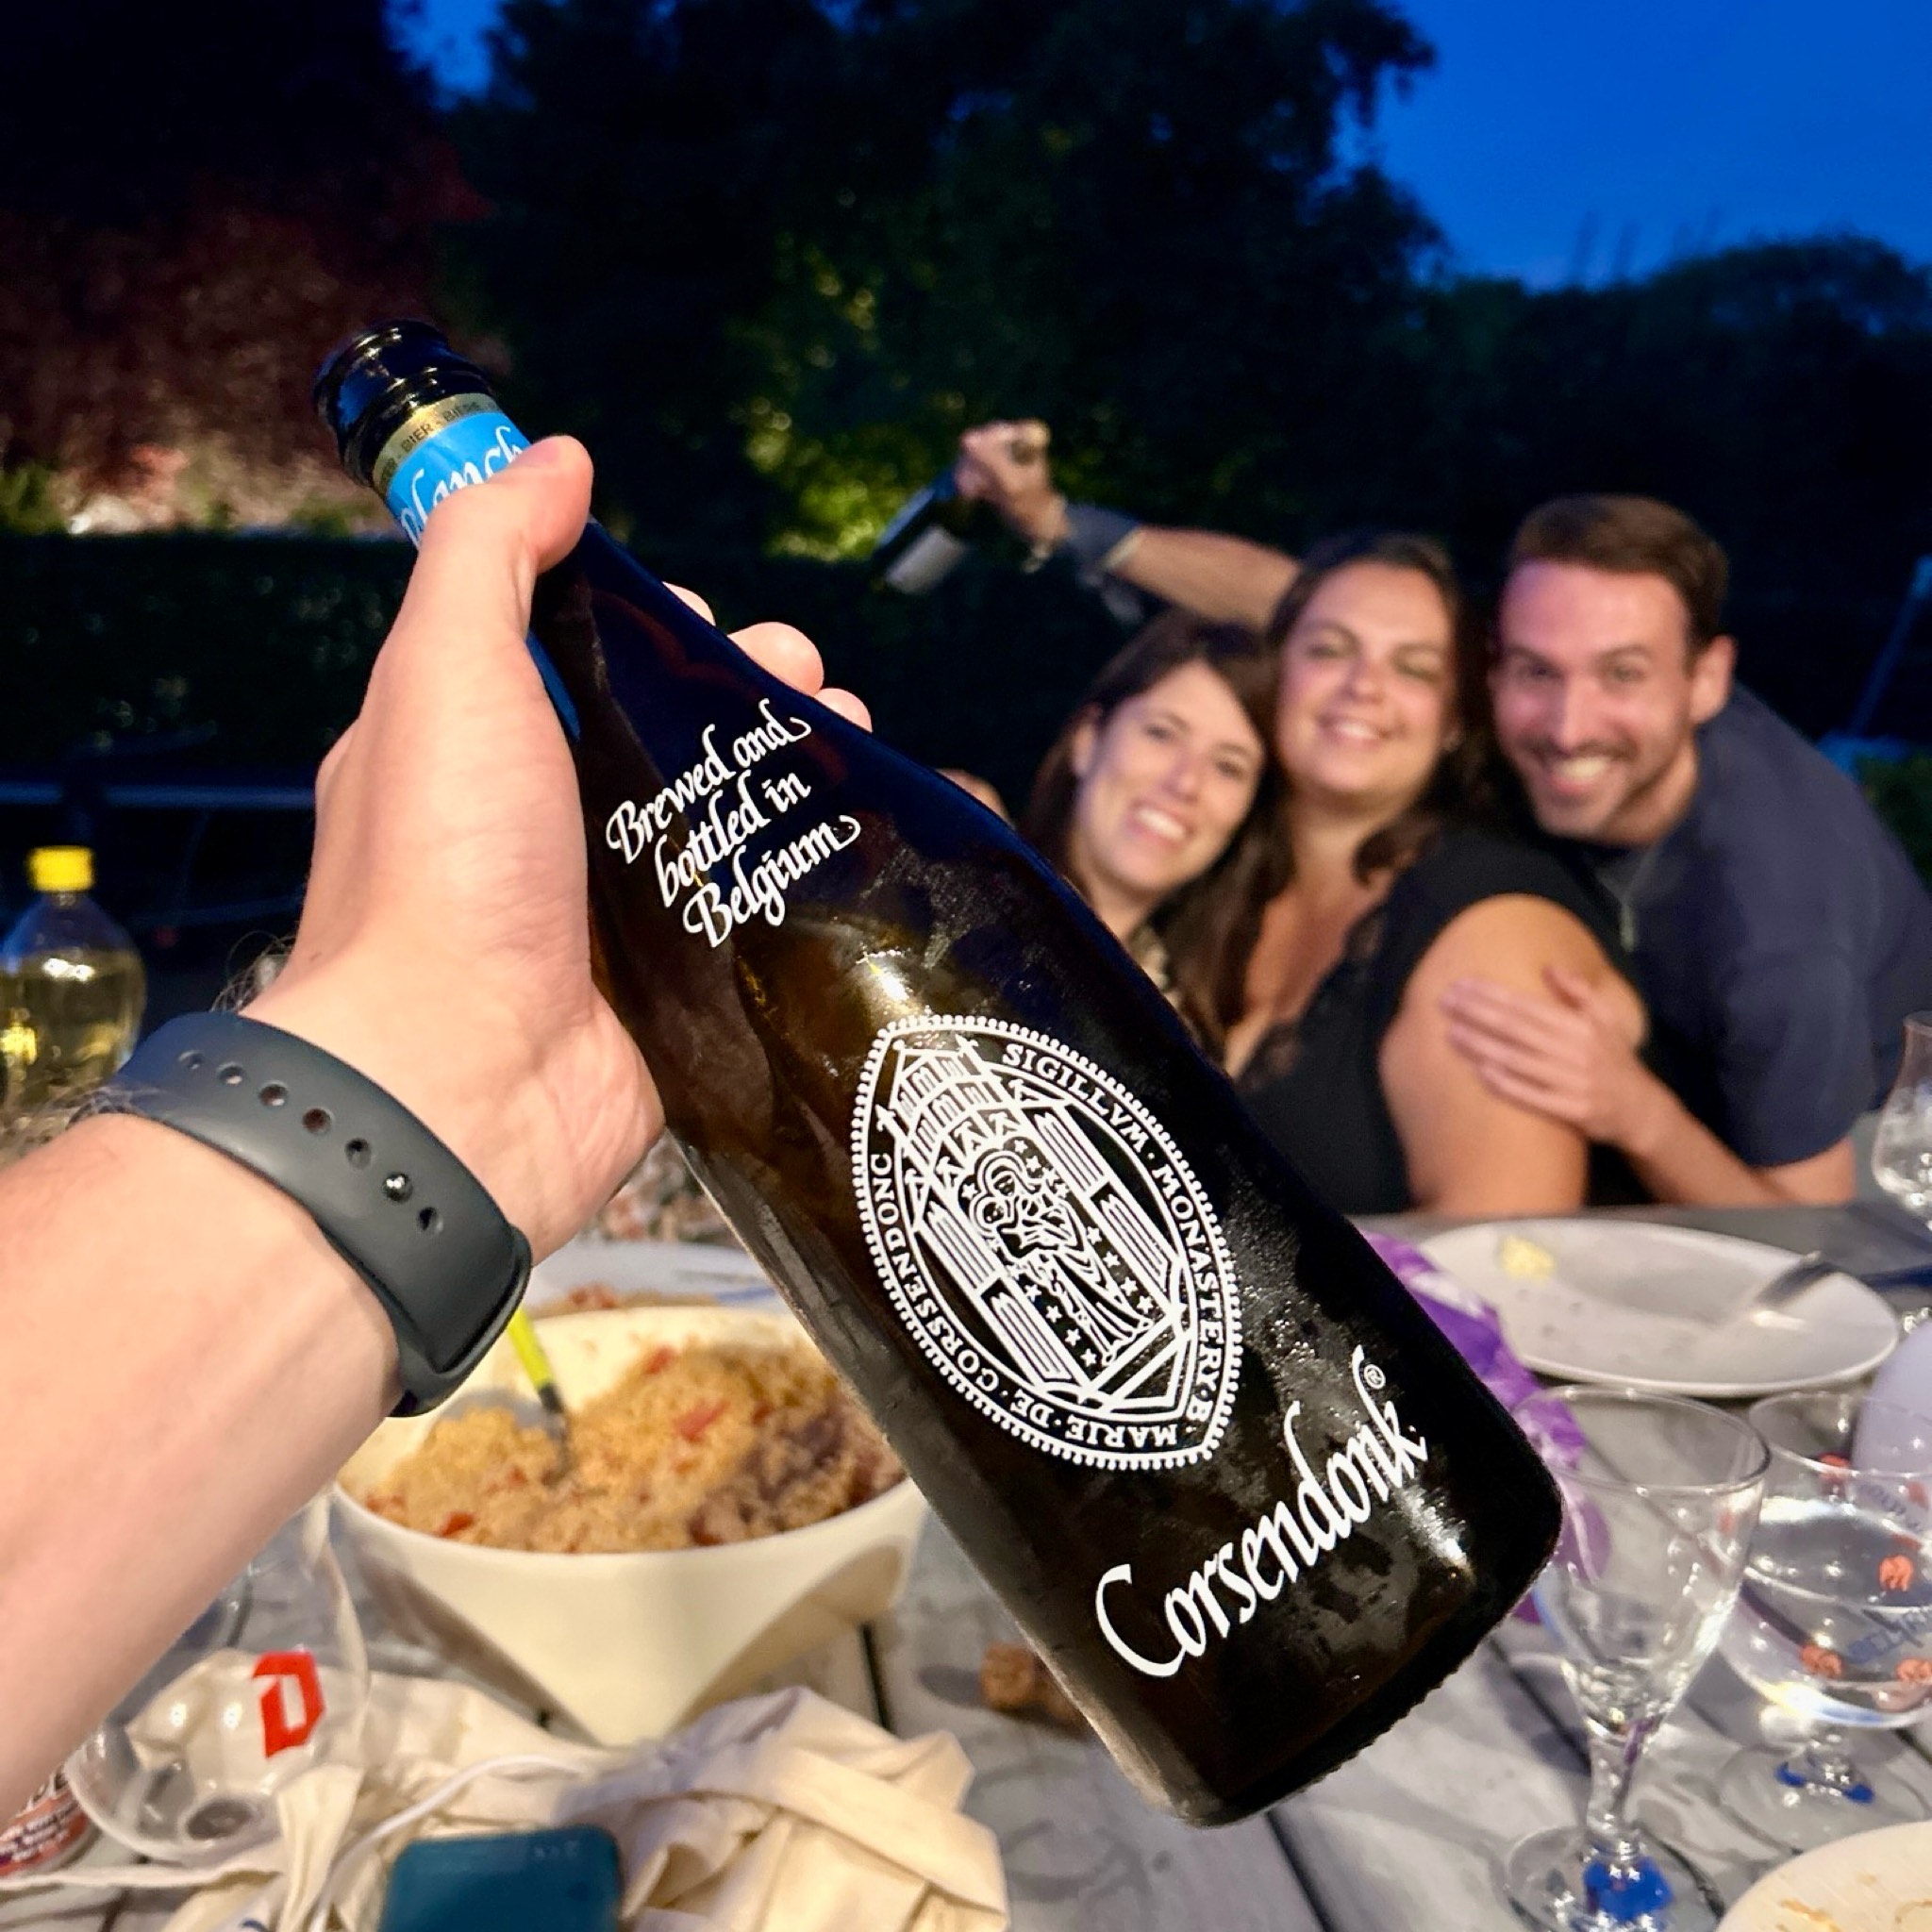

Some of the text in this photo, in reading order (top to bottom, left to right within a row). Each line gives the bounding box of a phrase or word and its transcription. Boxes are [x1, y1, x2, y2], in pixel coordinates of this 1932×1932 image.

[401, 423, 434, 453] BIER
[606, 698, 811, 864] Brewed and
[655, 770, 811, 908] bottled in
[683, 815, 860, 948] Belgium
[1002, 1043, 1150, 1153] SIGILLVM
[871, 1153, 1000, 1392] CORSSENDONC
[1010, 1389, 1055, 1429] DE
[1065, 1414, 1178, 1448] MARIE
[1095, 1344, 1427, 1677] Corsendonk
